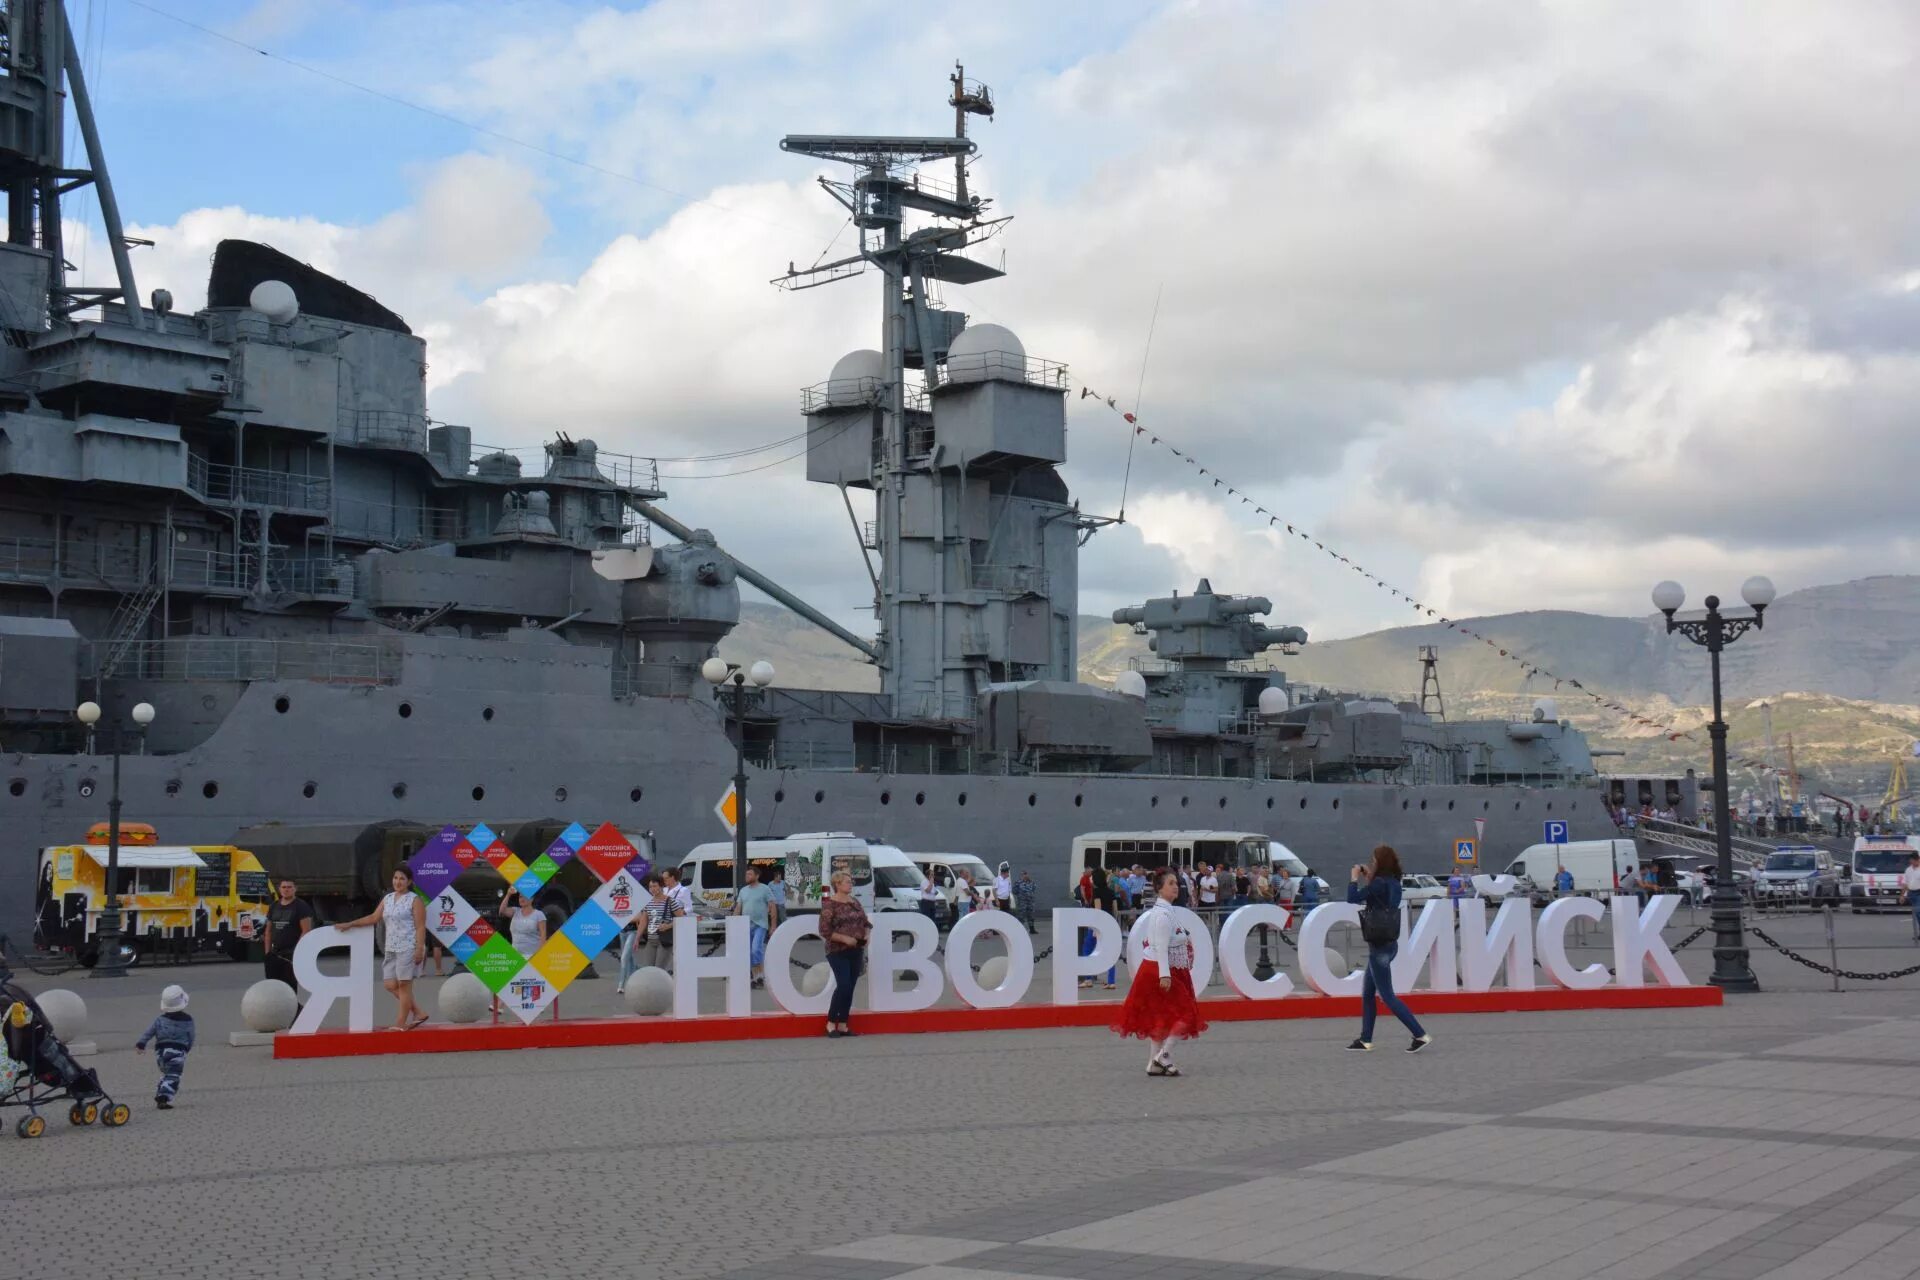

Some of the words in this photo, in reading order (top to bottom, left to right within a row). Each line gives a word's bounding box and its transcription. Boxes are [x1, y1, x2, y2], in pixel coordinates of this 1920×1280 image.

[1550, 823, 1564, 842] P
[613, 895, 630, 910] 75
[439, 912, 455, 926] 75
[288, 924, 375, 1035] Я
[673, 873, 1690, 1019] НОВОРОССИЙСК
